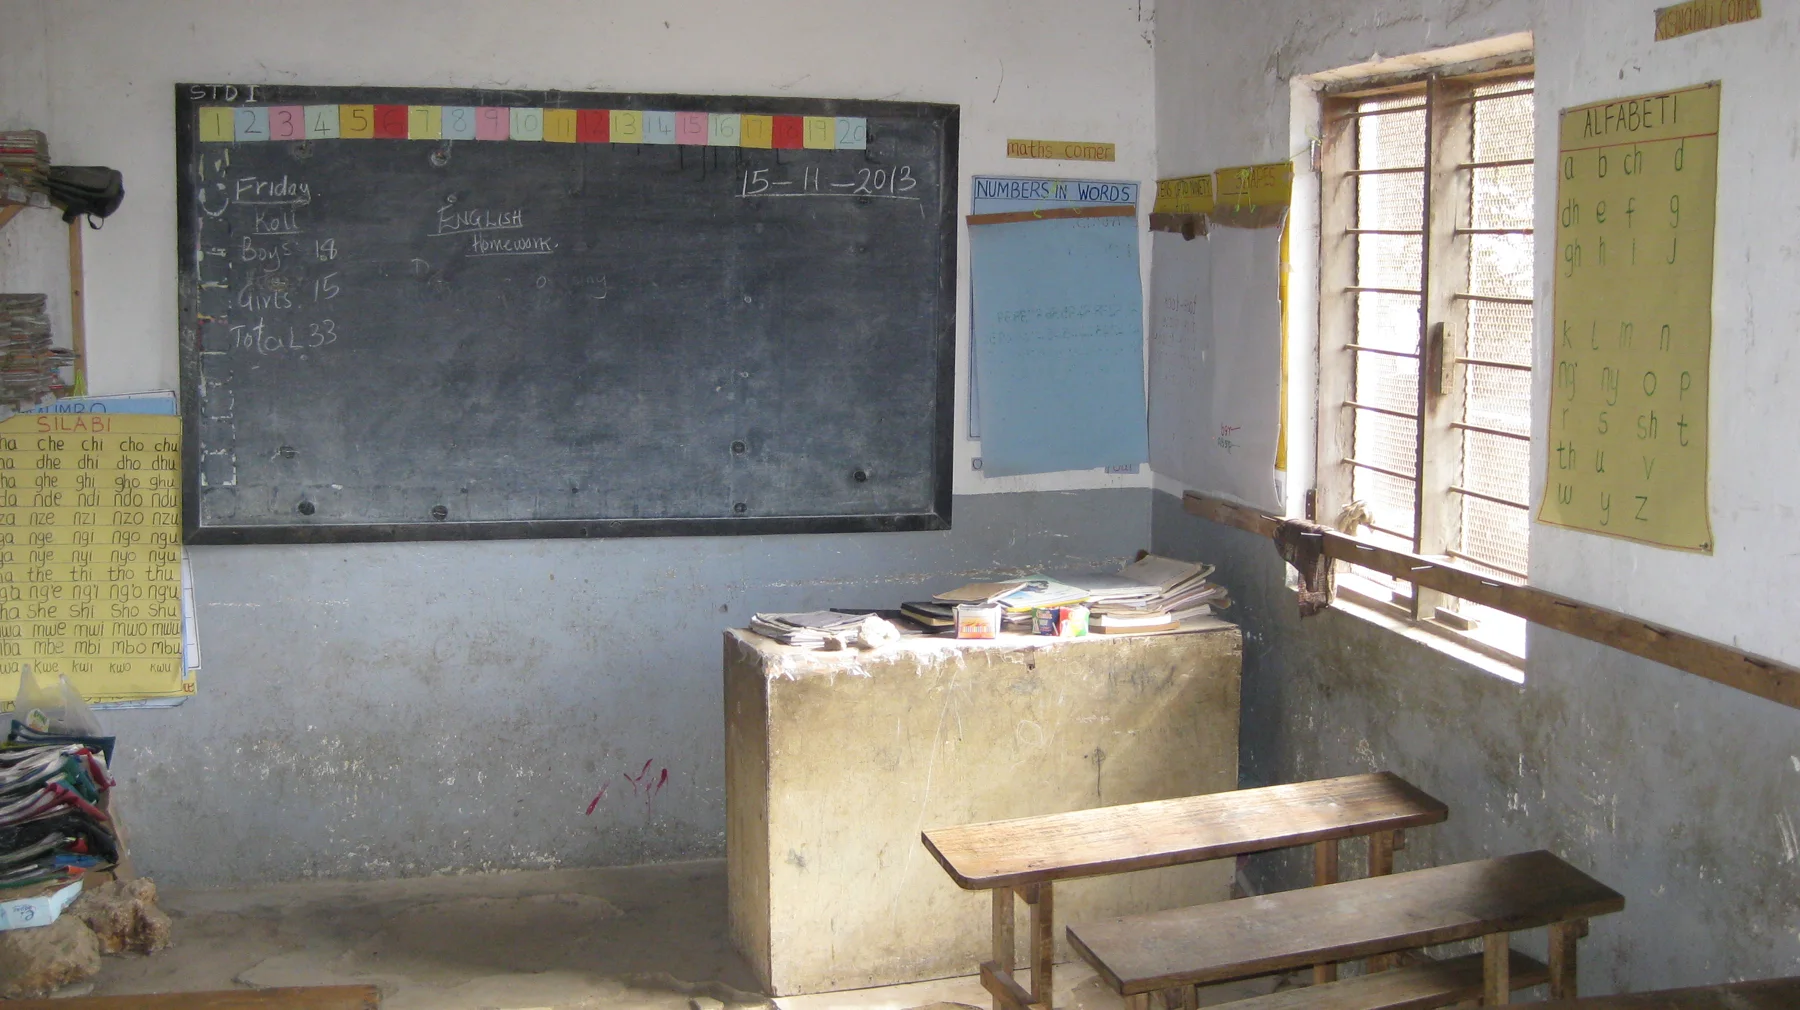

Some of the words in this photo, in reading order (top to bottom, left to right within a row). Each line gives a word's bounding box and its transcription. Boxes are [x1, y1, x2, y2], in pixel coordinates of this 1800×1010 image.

[190, 84, 238, 102] STD
[244, 111, 262, 135] 2
[279, 111, 294, 136] 3
[314, 111, 331, 136] 4
[351, 109, 368, 131] 5
[415, 109, 429, 132] 7
[452, 110, 467, 132] 8
[485, 109, 498, 134] 9
[515, 111, 538, 135] 10
[557, 117, 570, 137] 11
[614, 113, 636, 135] 13
[648, 115, 671, 135] 14
[683, 117, 702, 134] 15
[1583, 95, 1678, 138] ALFABETI
[713, 120, 734, 138] 16
[745, 119, 763, 138] 17
[808, 119, 827, 142] 19
[839, 118, 865, 145] 20
[1007, 140, 1053, 158] maths
[1564, 155, 1575, 180] a
[1598, 147, 1608, 178] b
[1623, 143, 1642, 176] ch
[1674, 137, 1685, 172] d
[977, 180, 1050, 199] NUMBERS
[1055, 184, 1068, 199] IN
[1078, 183, 1131, 202] WORDS
[437, 204, 523, 234] ENGLISH
[1561, 198, 1580, 229] dh
[1596, 200, 1606, 225] e
[1625, 197, 1636, 228] f
[1669, 194, 1680, 229] g
[1564, 236, 1581, 278] gh
[315, 272, 340, 302] 15
[308, 319, 338, 348] 33
[1563, 319, 1572, 349] k
[1619, 321, 1634, 349] m
[1659, 323, 1671, 351] n
[1601, 366, 1620, 406] ny
[1643, 371, 1657, 397] o
[1680, 370, 1691, 402] p
[37, 416, 112, 433] SILABI
[1677, 413, 1689, 447] t
[0, 437, 18, 451] ha
[37, 435, 65, 451] che
[81, 435, 103, 451] chi
[119, 436, 145, 452] cho
[154, 437, 179, 452] chu
[36, 453, 62, 470] dhe
[78, 454, 99, 470] dhi
[116, 454, 142, 471] dho
[151, 454, 177, 471] dhu
[1556, 440, 1576, 471] th
[1595, 450, 1605, 474] u
[0, 472, 16, 488] ha
[35, 471, 58, 493] ghe
[75, 471, 96, 491] ghi
[114, 473, 141, 493] gho
[149, 473, 175, 491] ghu
[0, 489, 18, 507] da
[34, 489, 63, 507] nde
[77, 489, 100, 507] ndi
[113, 488, 143, 508] ndo
[151, 489, 179, 508] ndu
[1558, 483, 1573, 506] w
[1600, 491, 1611, 526] y
[0, 512, 16, 526] za
[29, 511, 56, 526] nze
[73, 512, 96, 525] nzi
[112, 510, 145, 526] nzo
[152, 512, 179, 526] nzu
[28, 531, 53, 549] nge
[72, 529, 94, 548] ngi
[111, 530, 141, 548] ngo
[150, 531, 179, 550] ngu
[29, 550, 54, 568] nye
[71, 550, 93, 568] nyi
[110, 550, 137, 567] nyo
[148, 550, 177, 567] nyu
[27, 567, 53, 583] the
[69, 567, 92, 582] thi
[107, 566, 135, 582] tho
[145, 566, 174, 582] thu
[0, 603, 20, 620] ha
[0, 623, 22, 638] wa
[32, 621, 67, 638] mwe
[73, 621, 105, 637] mwi
[112, 621, 148, 637] mwo
[151, 621, 181, 637] mwu
[0, 640, 21, 656] ba
[33, 639, 65, 655] mbe
[74, 638, 101, 655] mbi
[111, 640, 147, 655] mbo
[151, 641, 183, 655] mbu
[0, 661, 20, 675] wa
[34, 659, 60, 675] kwe
[72, 659, 94, 674] kwi
[109, 662, 133, 674] kwo
[150, 662, 172, 674] kwu
